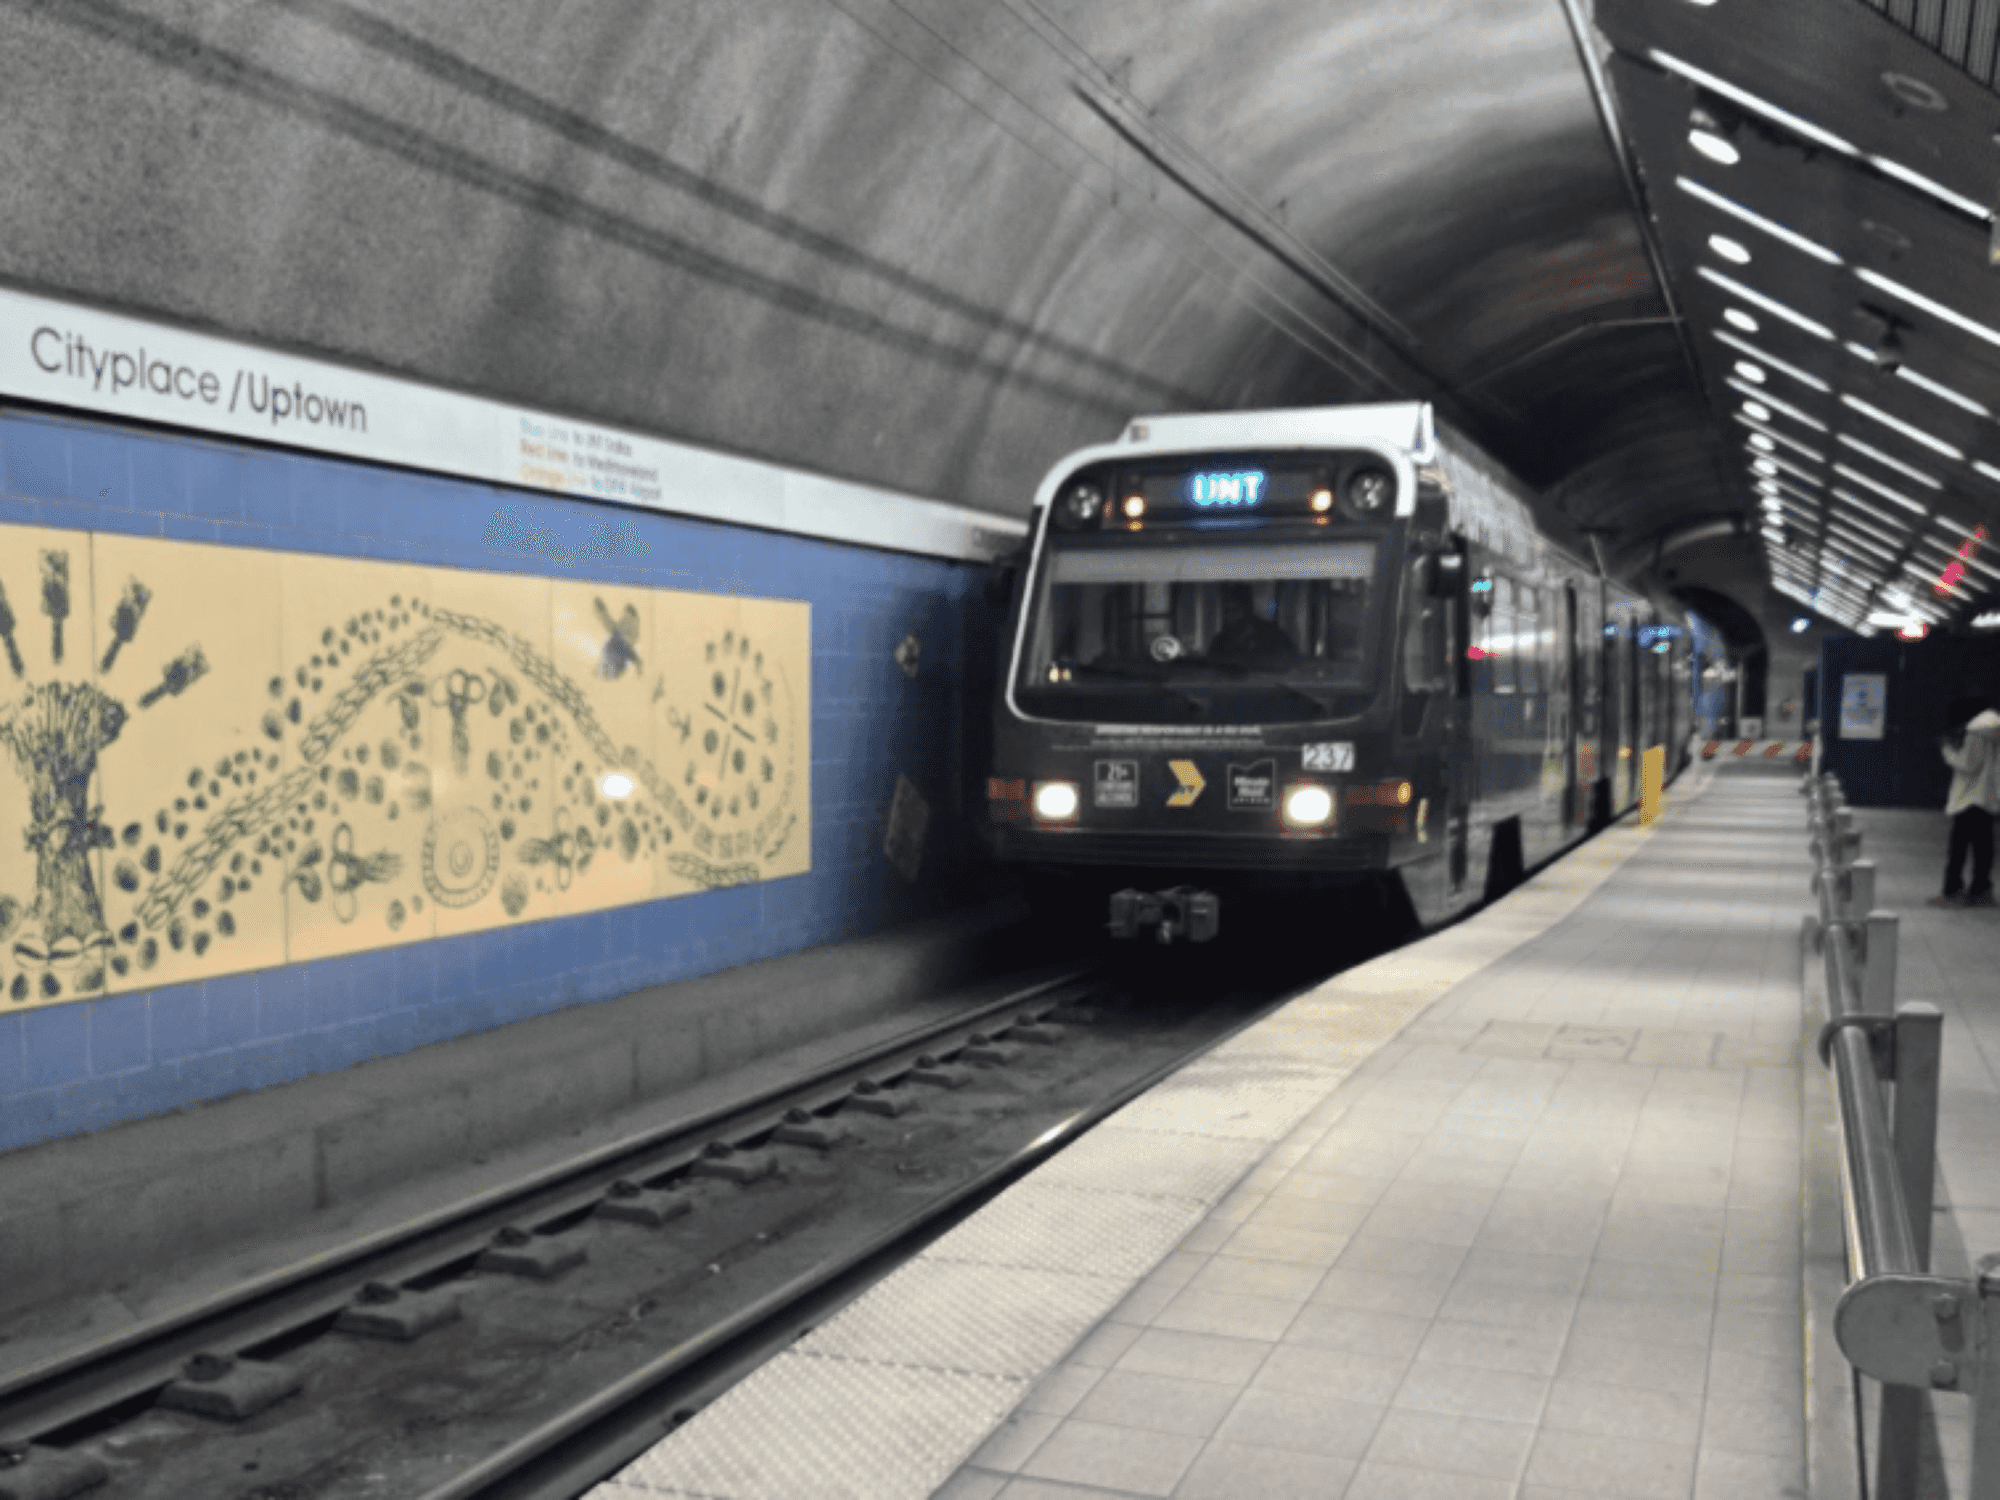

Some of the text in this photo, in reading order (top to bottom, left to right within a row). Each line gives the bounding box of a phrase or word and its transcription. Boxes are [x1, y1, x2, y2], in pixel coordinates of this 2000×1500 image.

[31, 326, 221, 405] Cityplace
[1193, 472, 1264, 506] UNT
[1304, 744, 1353, 769] 237
